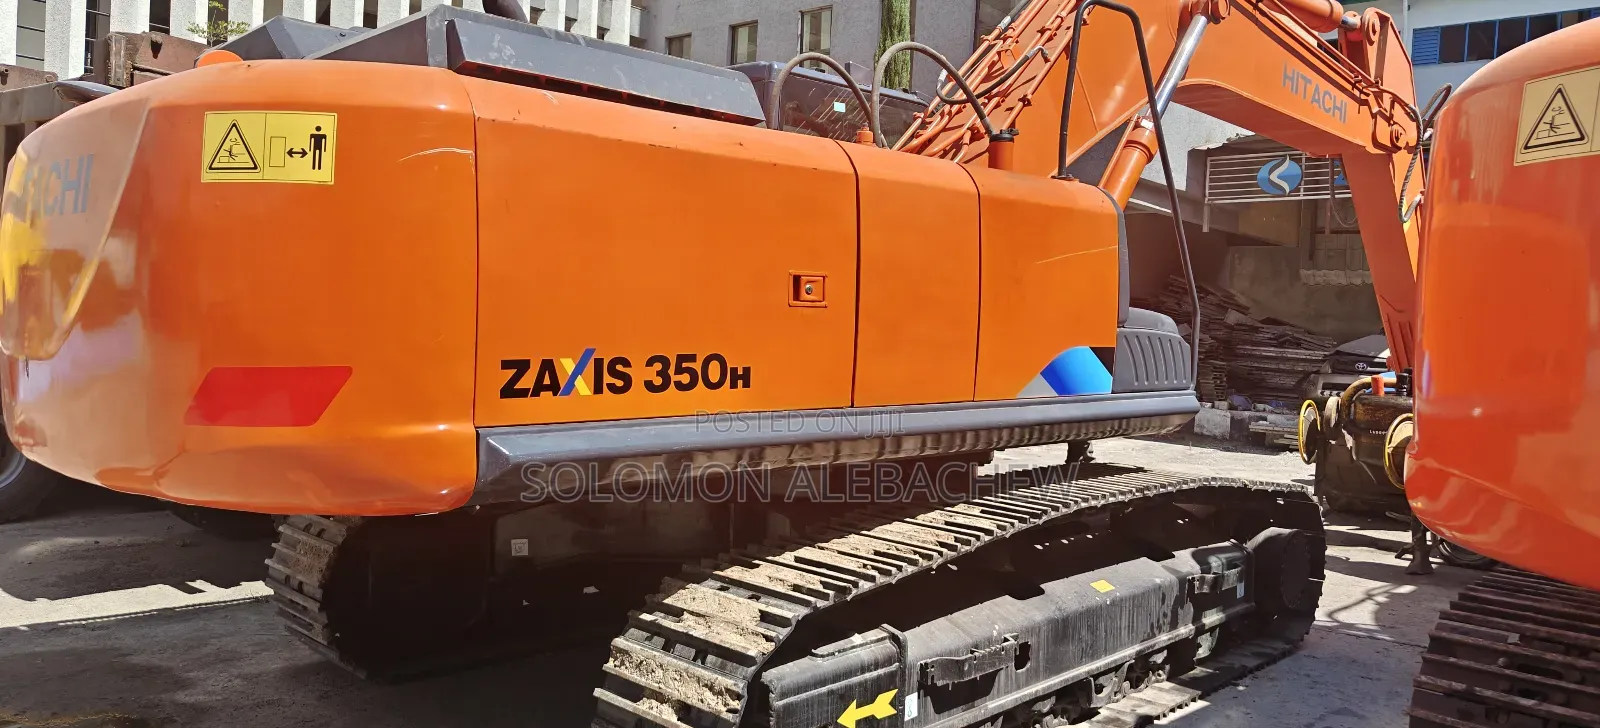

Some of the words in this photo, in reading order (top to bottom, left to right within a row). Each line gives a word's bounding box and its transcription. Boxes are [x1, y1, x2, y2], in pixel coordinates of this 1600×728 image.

[1282, 62, 1348, 124] HITACHI
[500, 348, 633, 399] ZAXIS
[643, 353, 751, 393] 350H
